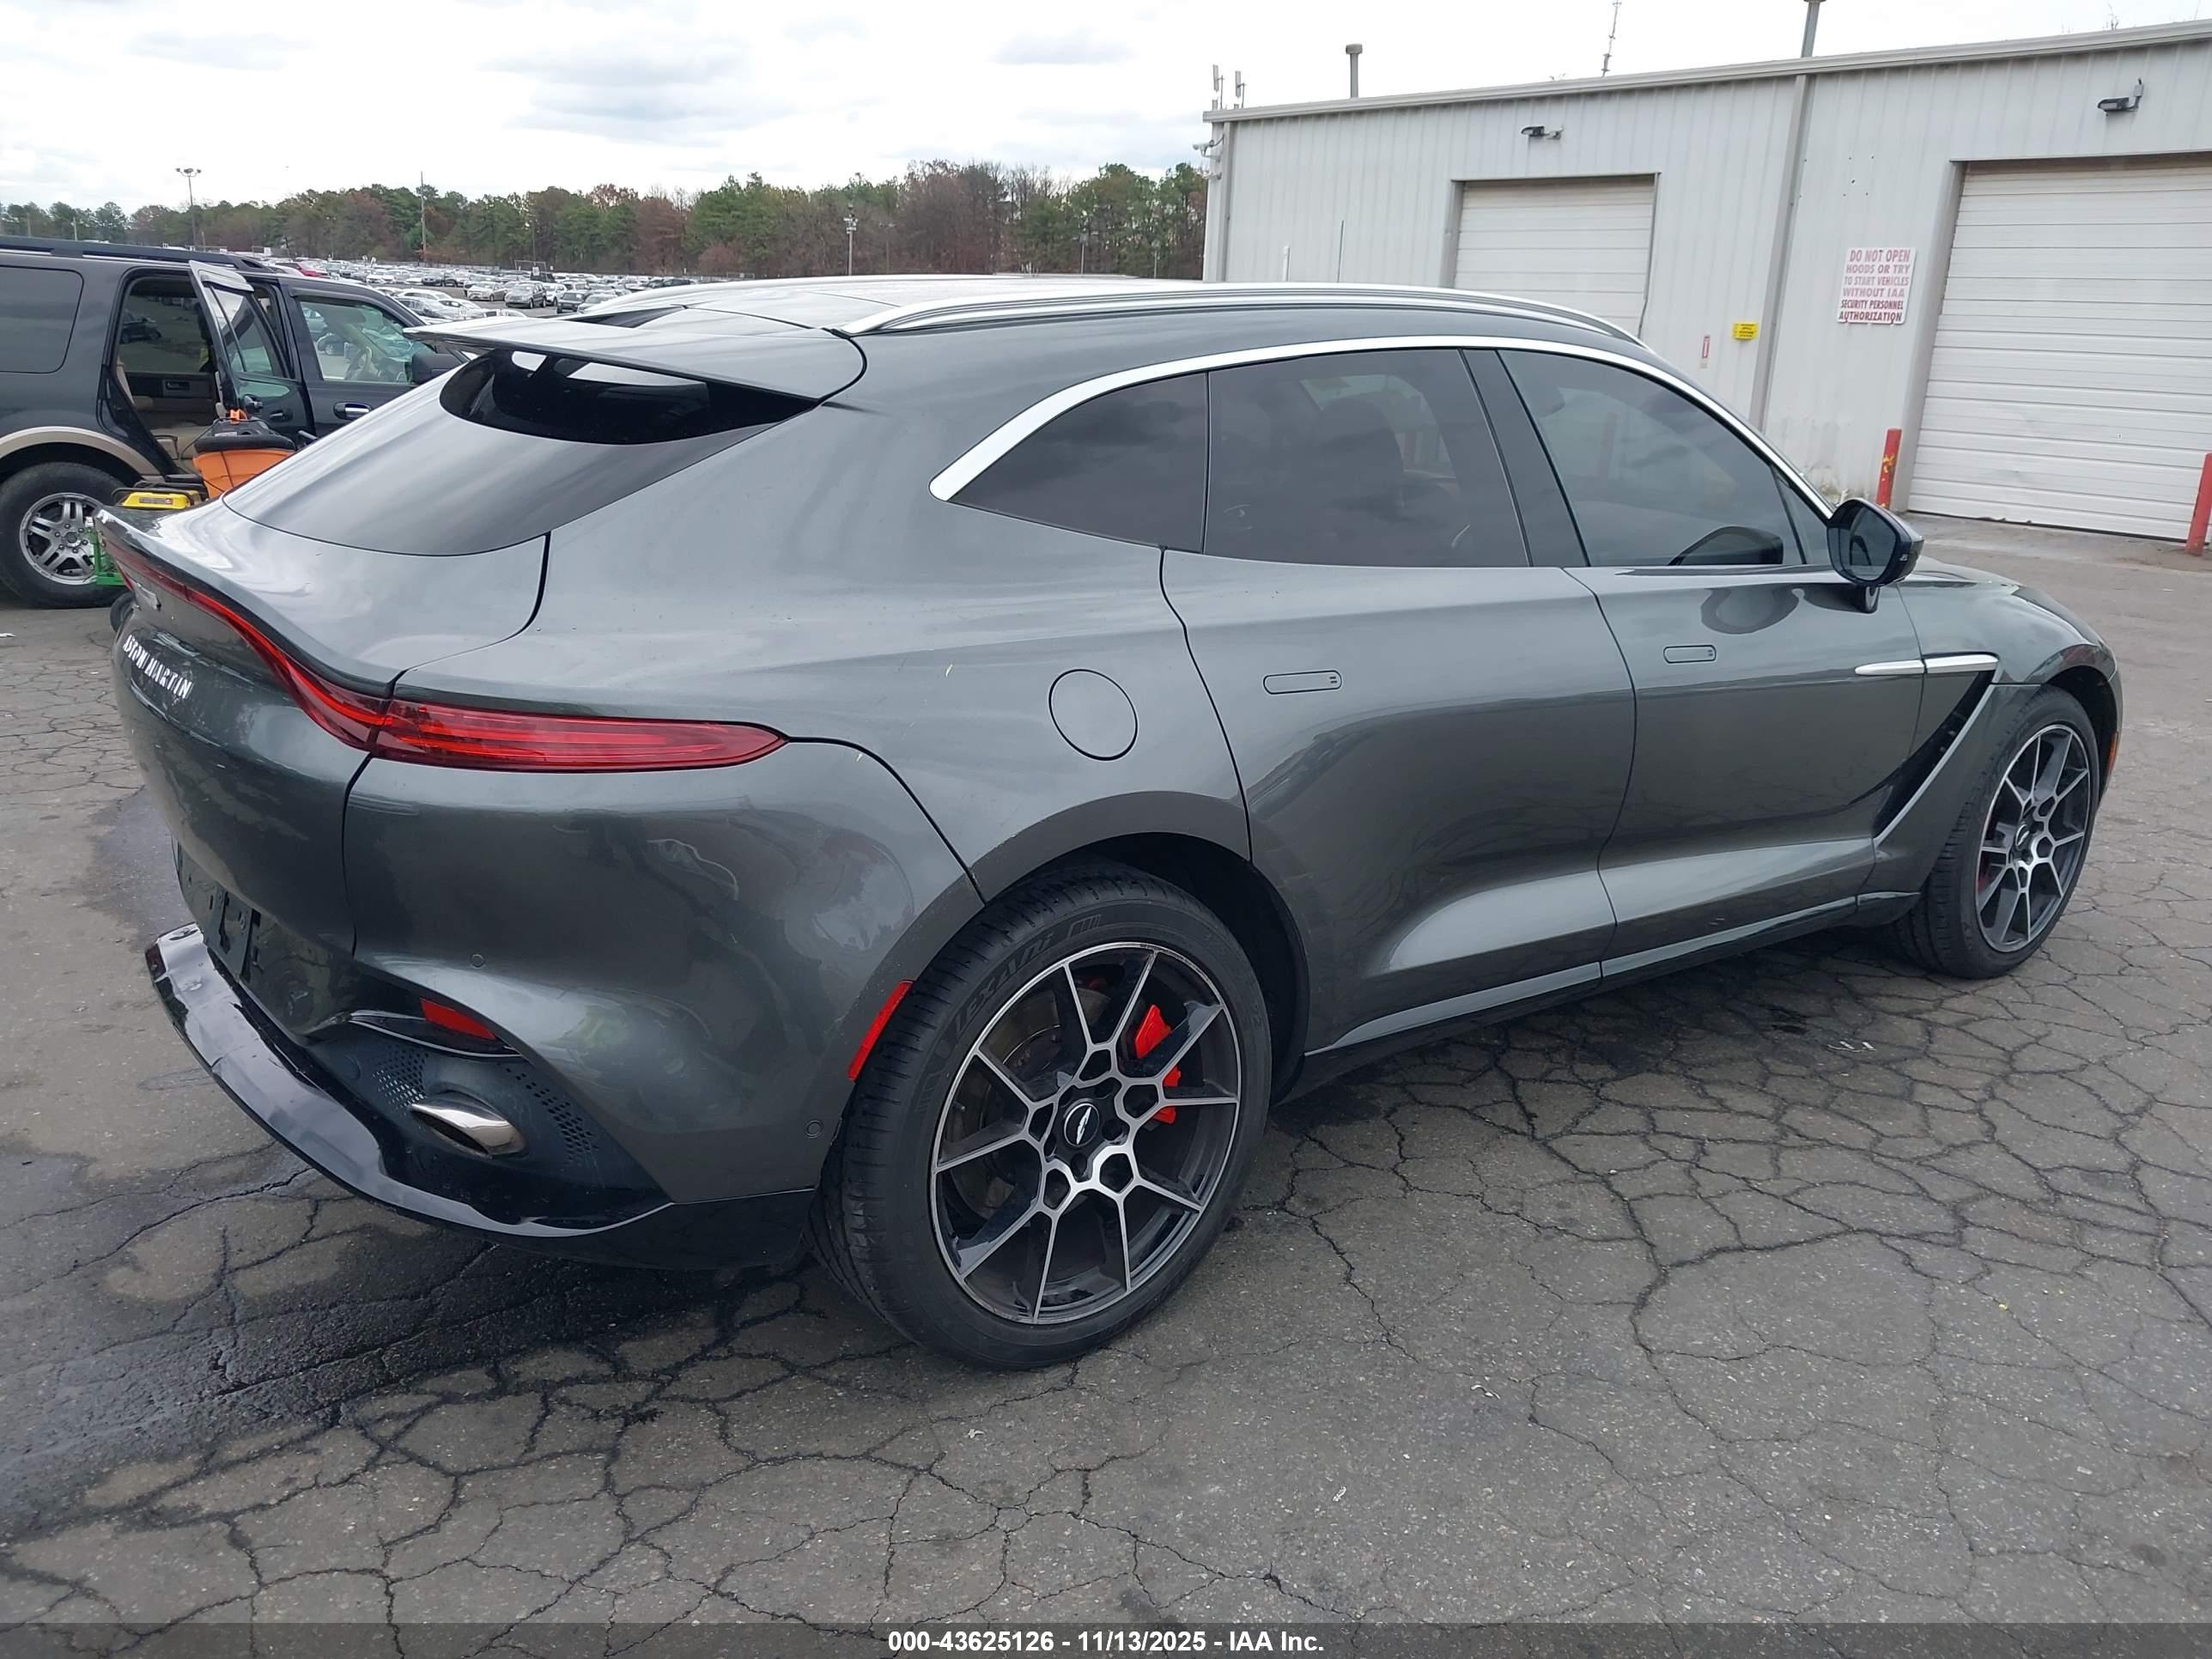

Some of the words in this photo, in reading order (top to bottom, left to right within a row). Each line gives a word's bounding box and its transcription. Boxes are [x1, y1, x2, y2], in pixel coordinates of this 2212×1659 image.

[1850, 250, 1863, 262] DO
[1865, 249, 1884, 262] NOT
[1886, 249, 1911, 262] OPEN
[1846, 264, 1875, 273] HOODS
[1878, 264, 1890, 274] OR
[1893, 264, 1911, 273] TRY
[1844, 276, 1853, 286] TO
[1854, 276, 1875, 286] START
[1877, 276, 1910, 286] VEHICLES
[1843, 288, 1885, 297] WITHOUT
[1887, 289, 1905, 297] IAA
[1841, 300, 1869, 308] SECURITY
[1869, 301, 1904, 310] PERSONNEL
[1838, 311, 1903, 322] AUTHORIZATION
[144, 658, 194, 700] MARTIN
